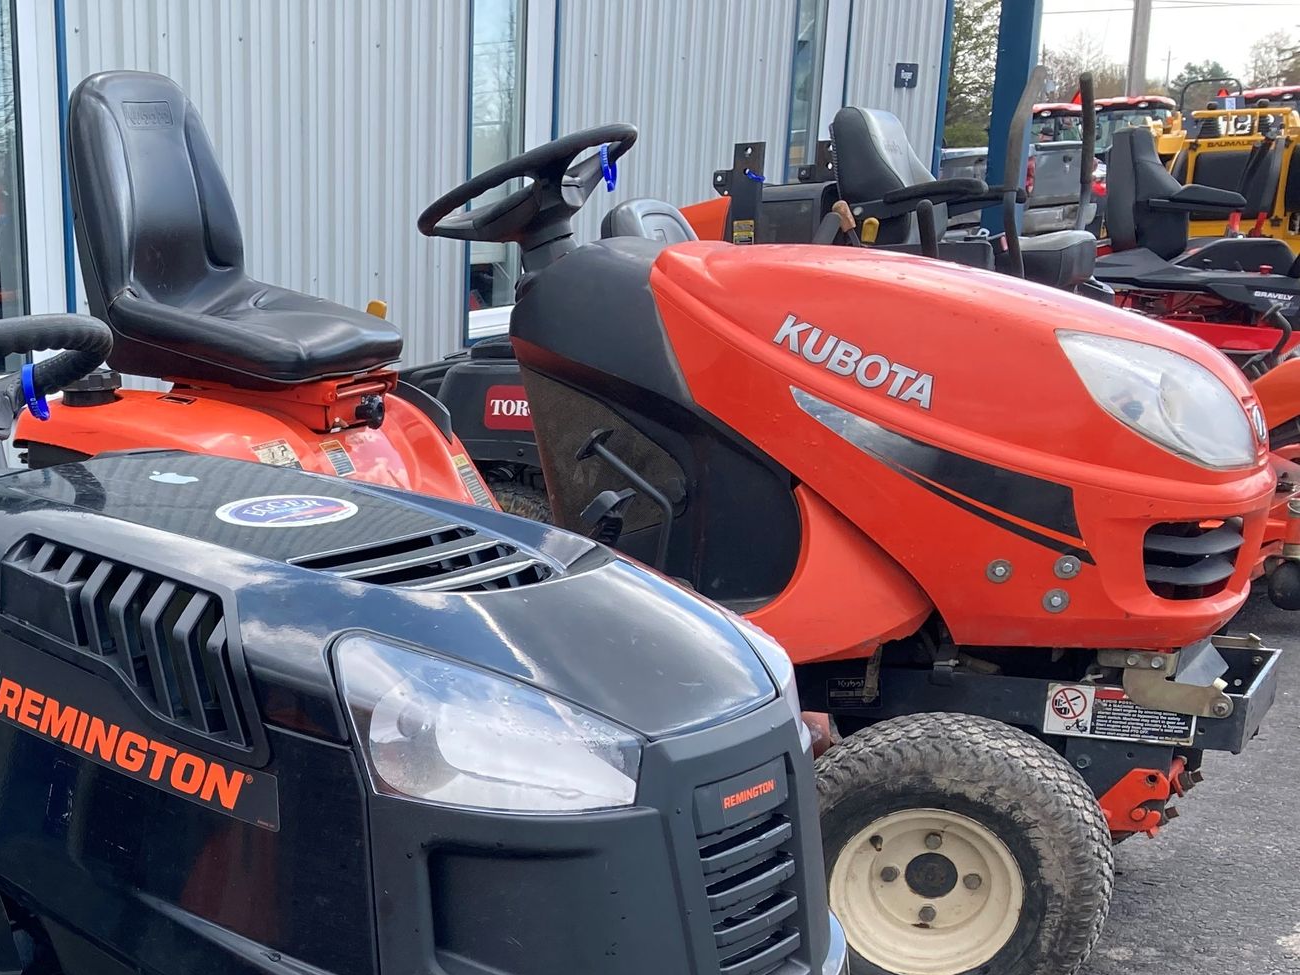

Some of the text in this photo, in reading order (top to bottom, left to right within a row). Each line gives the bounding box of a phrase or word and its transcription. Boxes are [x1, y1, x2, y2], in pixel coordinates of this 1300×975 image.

[1254, 291, 1294, 301] GRAVELY
[773, 313, 934, 410] KUBOTA
[490, 399, 531, 416] TOR
[723, 779, 775, 809] REMINGTON
